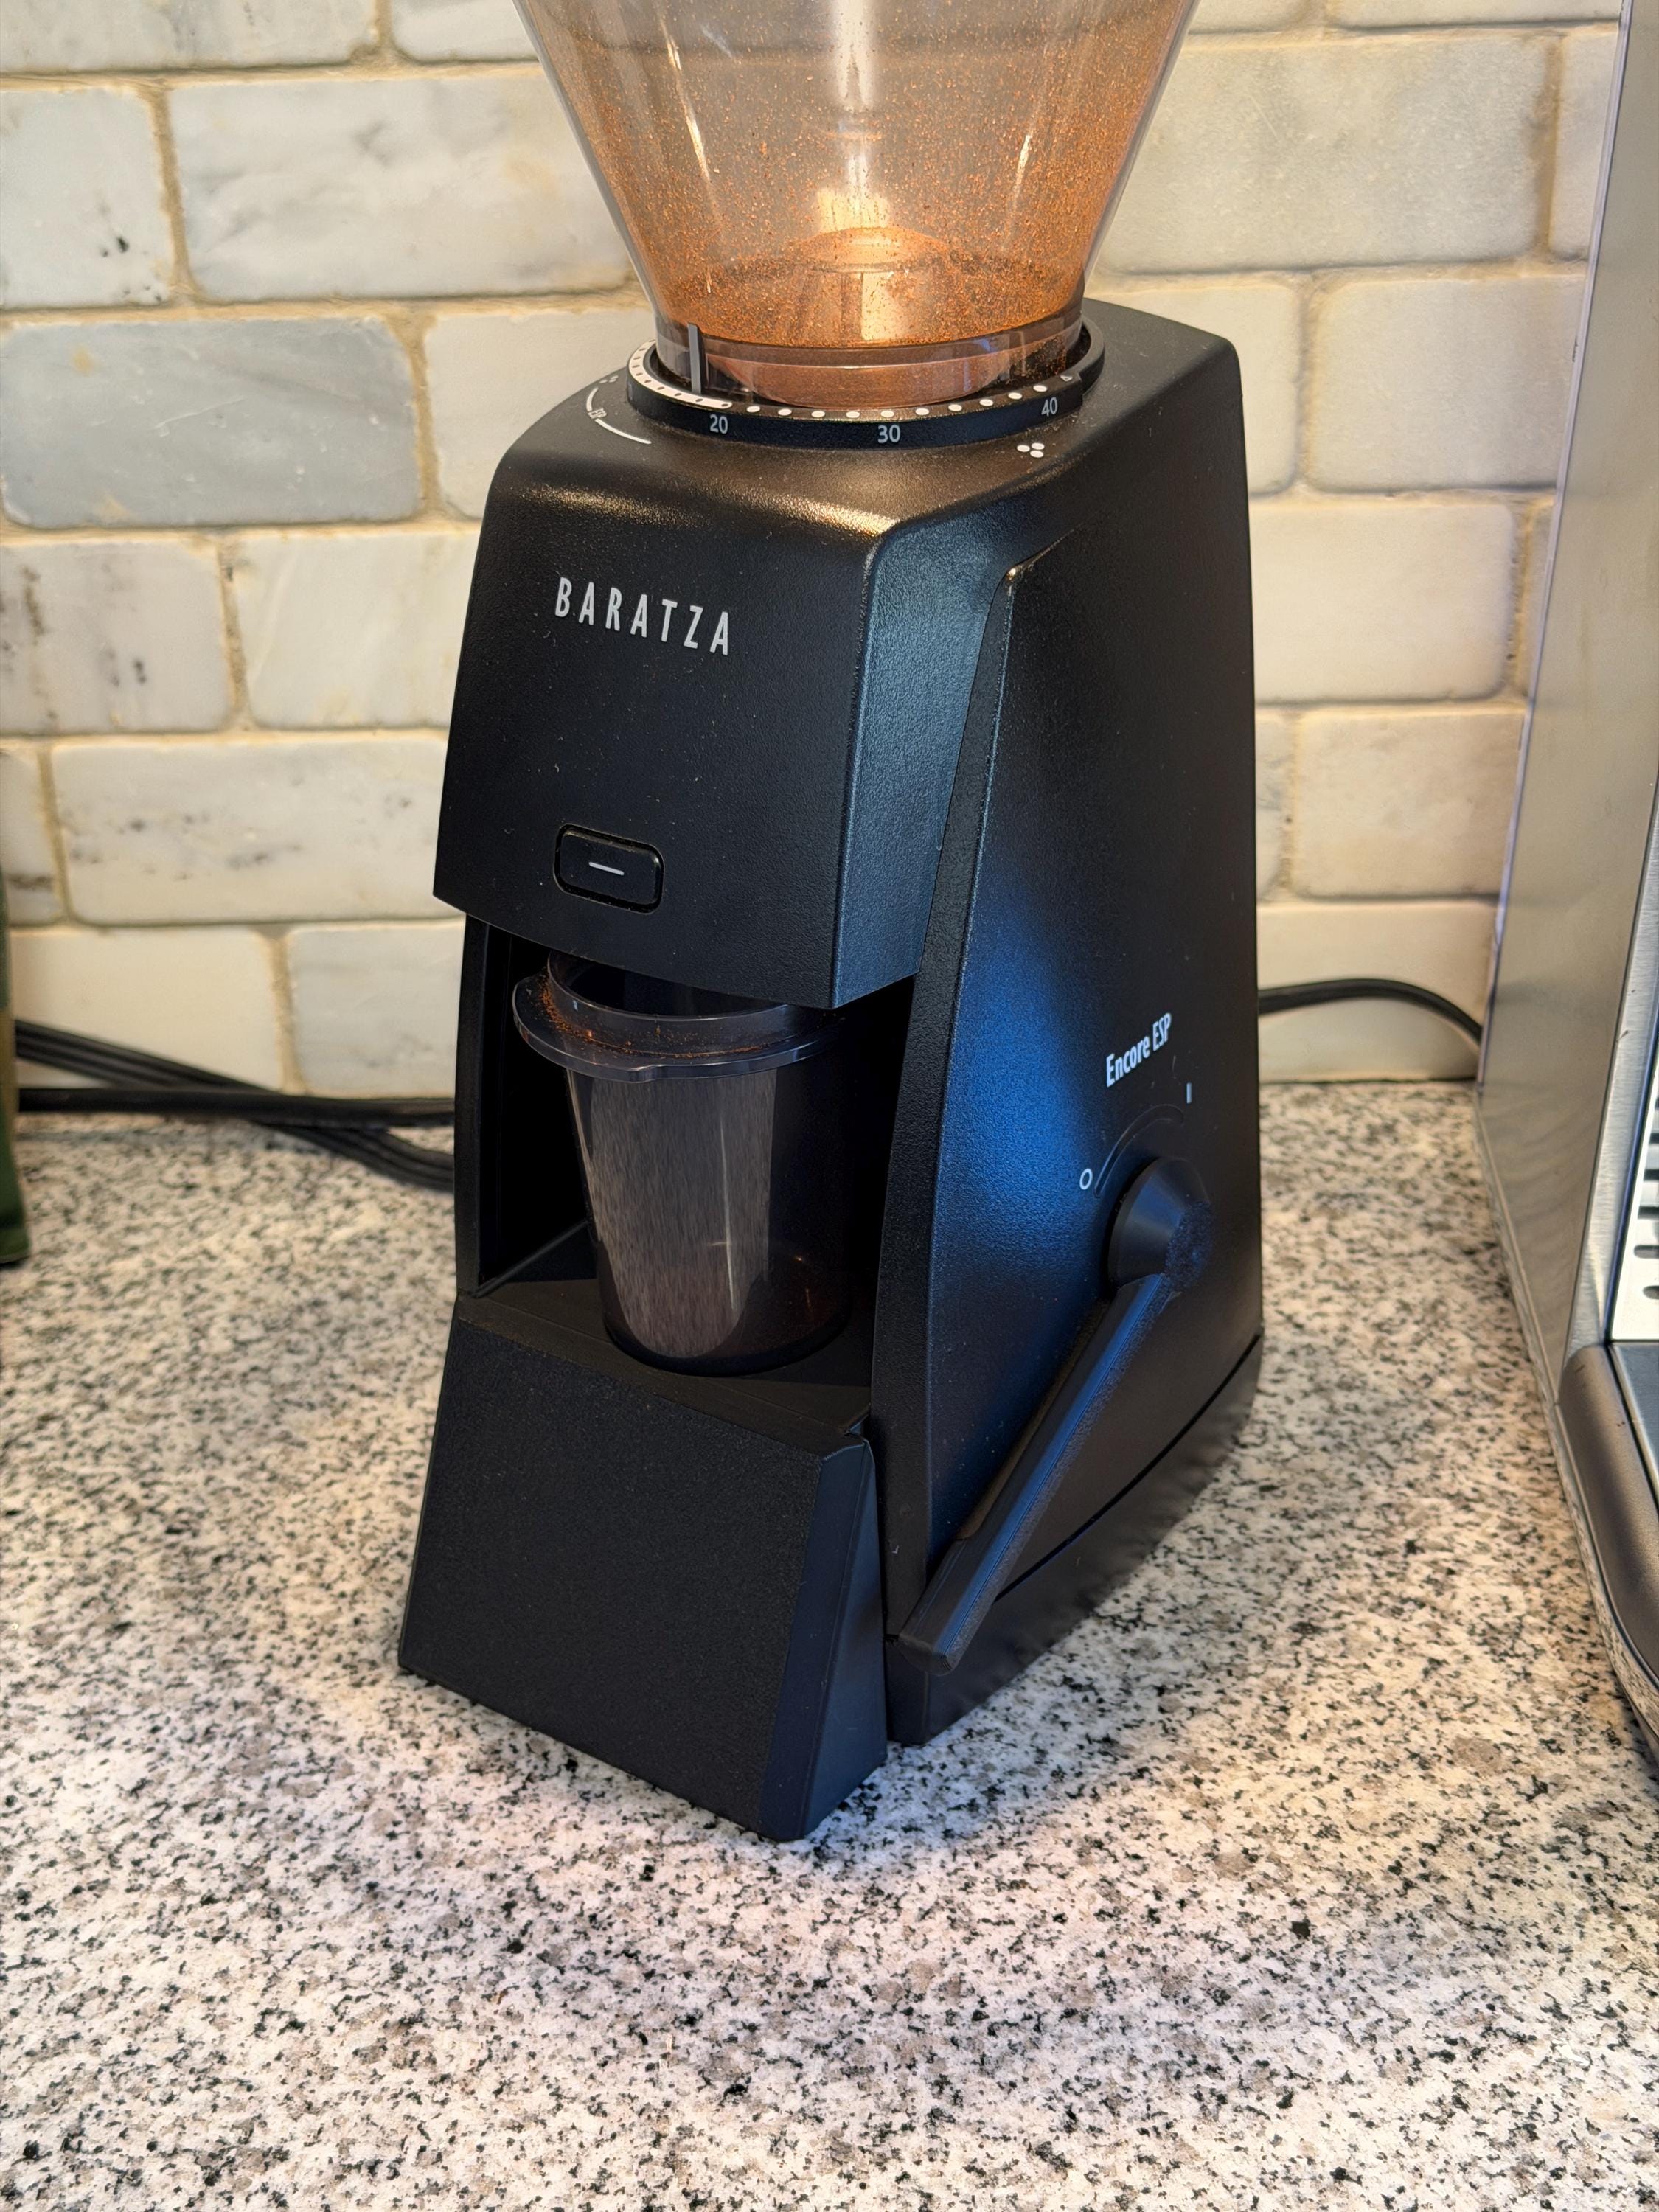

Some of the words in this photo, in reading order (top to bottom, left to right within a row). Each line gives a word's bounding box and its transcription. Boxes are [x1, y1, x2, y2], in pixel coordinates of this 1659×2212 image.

[710, 414, 728, 434] 20
[878, 425, 900, 443] 30
[1041, 397, 1058, 417] 40
[555, 577, 728, 655] BARATZA
[1106, 1036, 1150, 1088] Encore
[1152, 1012, 1172, 1051] ESP
